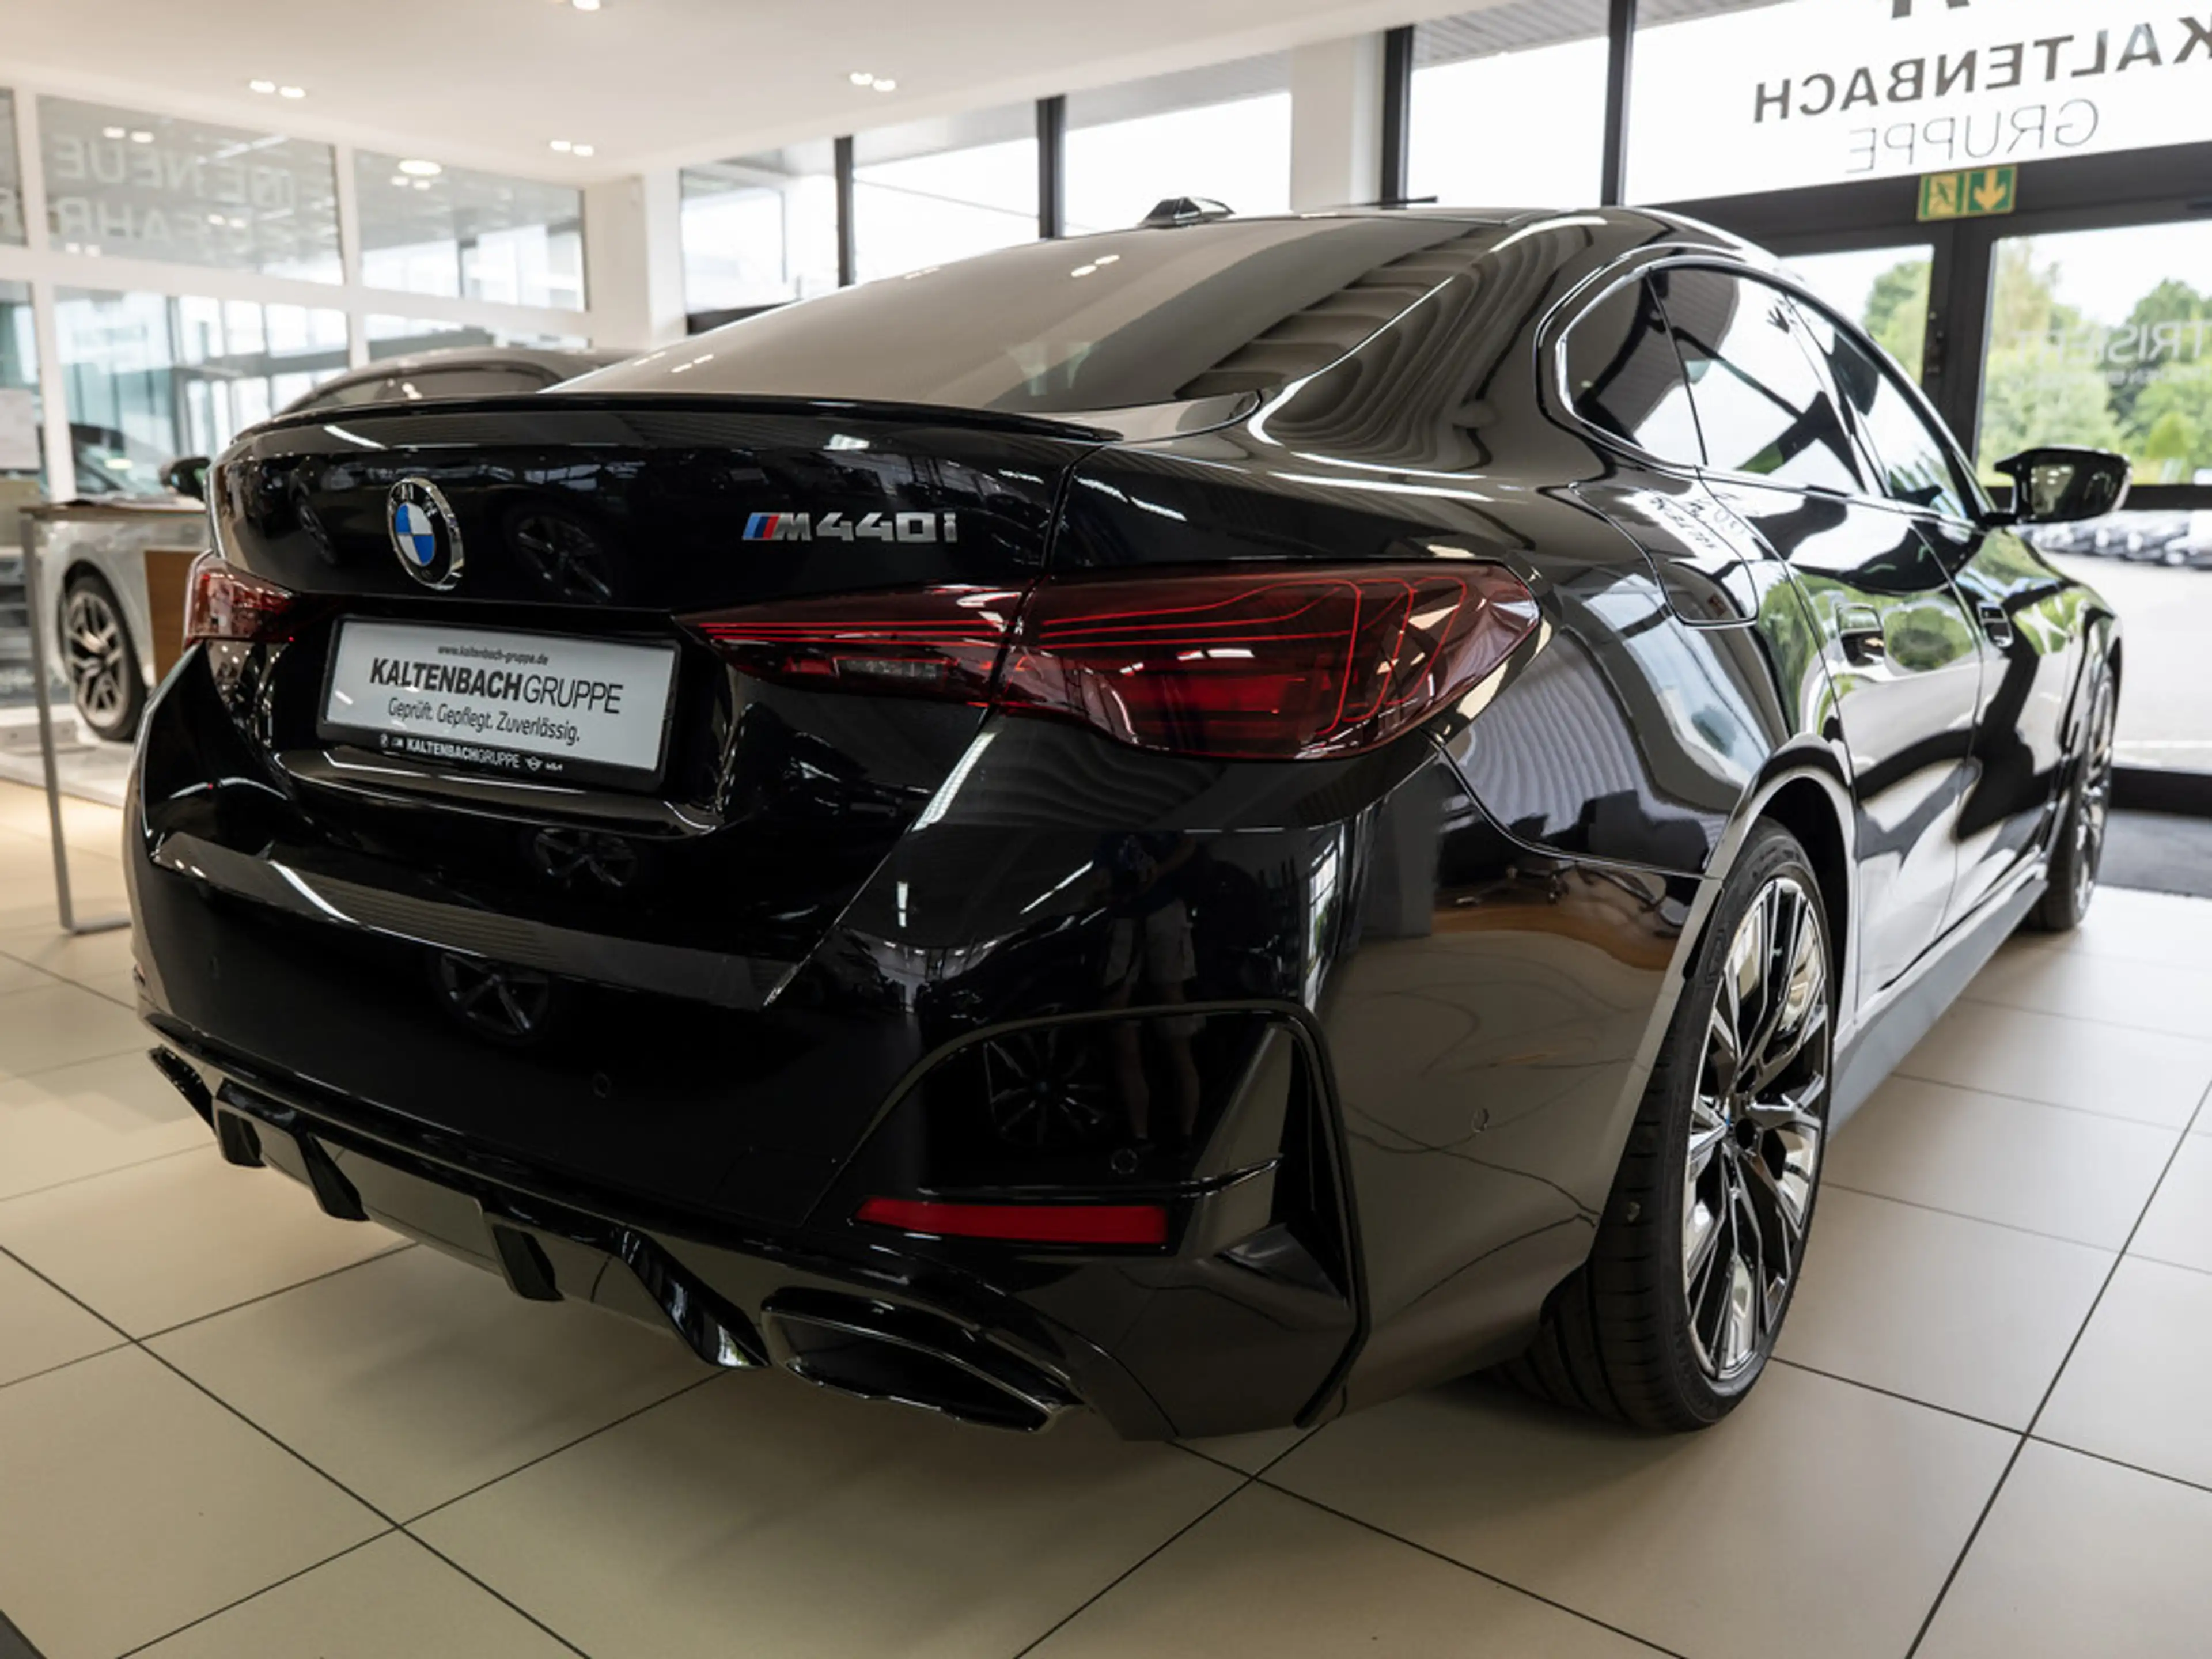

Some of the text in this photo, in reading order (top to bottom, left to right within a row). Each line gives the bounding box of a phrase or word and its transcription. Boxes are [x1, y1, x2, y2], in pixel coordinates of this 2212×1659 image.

[772, 512, 957, 543] M440i
[438, 646, 550, 666] www.kaltenbach-gruppe.de
[370, 657, 623, 714] KALTENBACHGRUPPE
[388, 697, 580, 746] Geprüft. Gepflegt. Zuverlässig.
[406, 738, 520, 768] KALTENBACHGRUPPE
